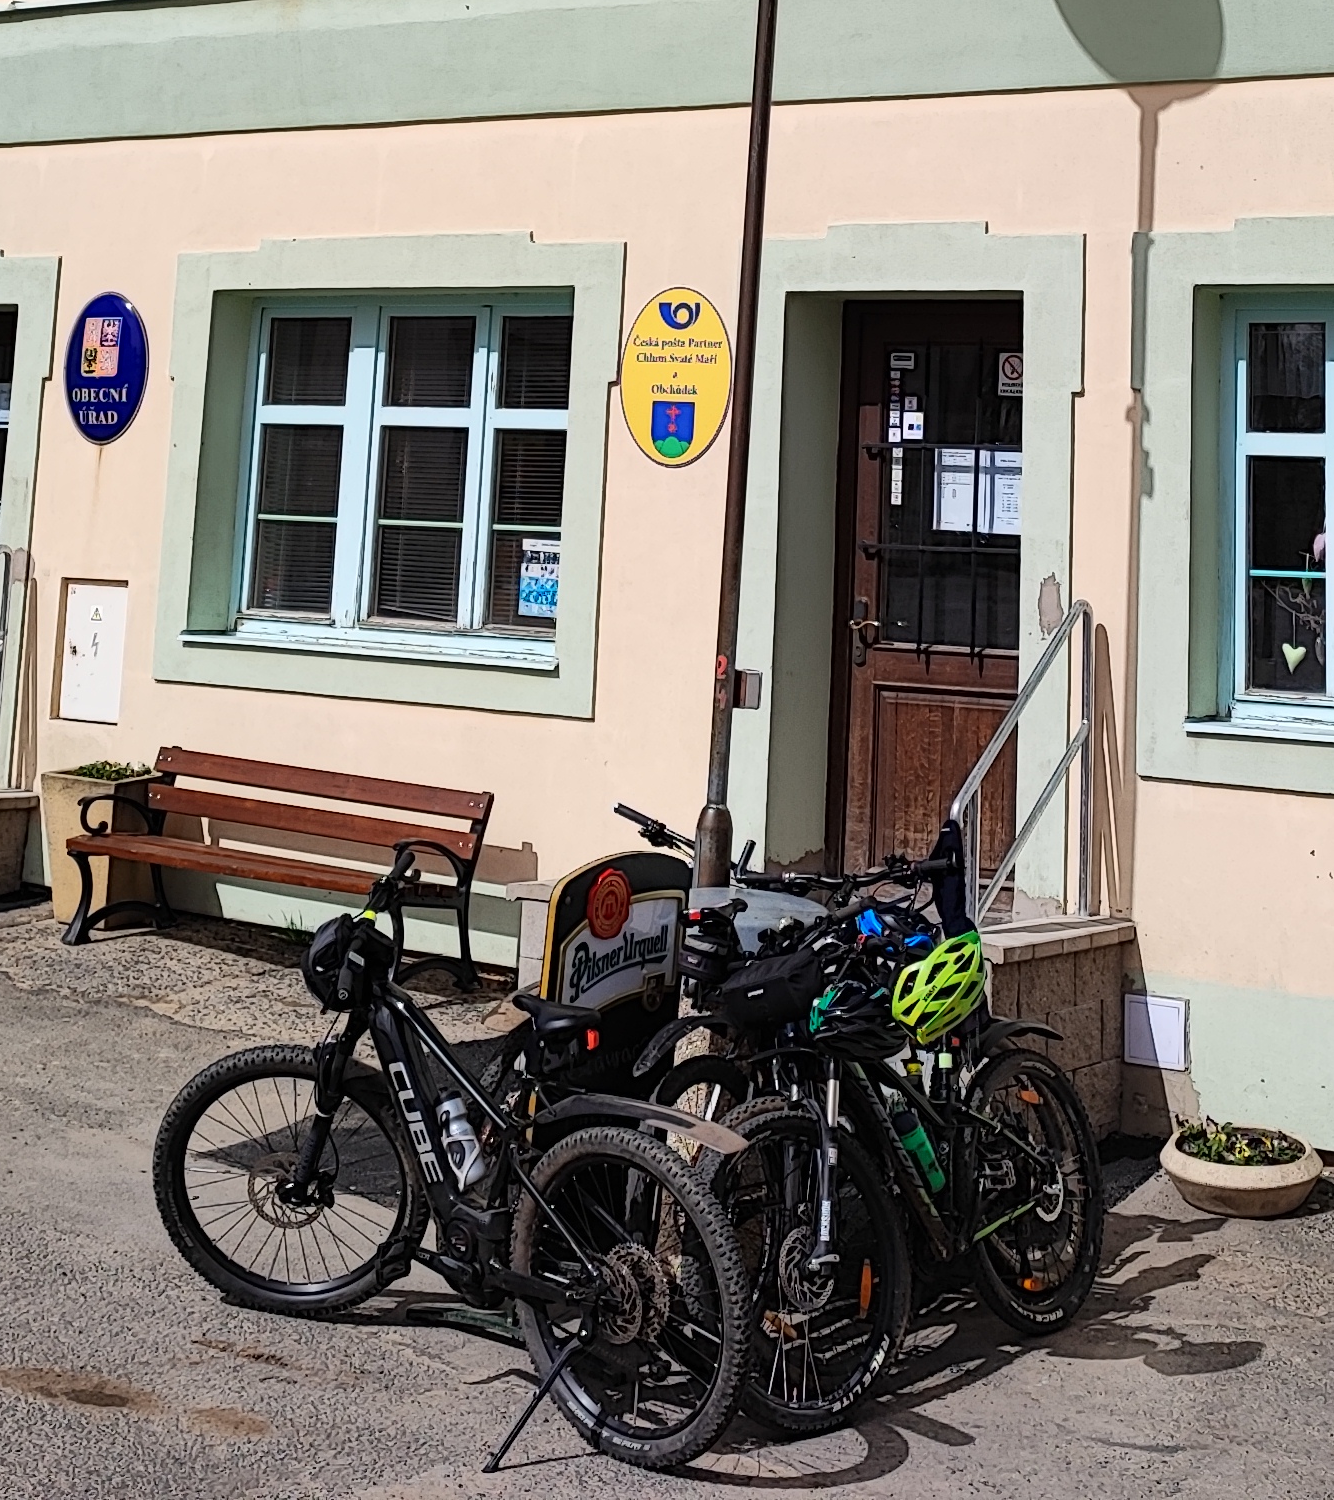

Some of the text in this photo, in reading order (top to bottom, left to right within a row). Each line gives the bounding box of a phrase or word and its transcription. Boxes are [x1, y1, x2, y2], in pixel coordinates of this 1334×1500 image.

[633, 334, 723, 350] Česká pošta Partner
[636, 352, 718, 364] Chlum Svaté Maří
[72, 383, 129, 403] OBECNÍ
[651, 384, 698, 396] Obchůdek
[79, 406, 119, 425] ÚŘAD
[569, 924, 669, 1003] Pilsner Urquell
[388, 1061, 445, 1184] CUBE
